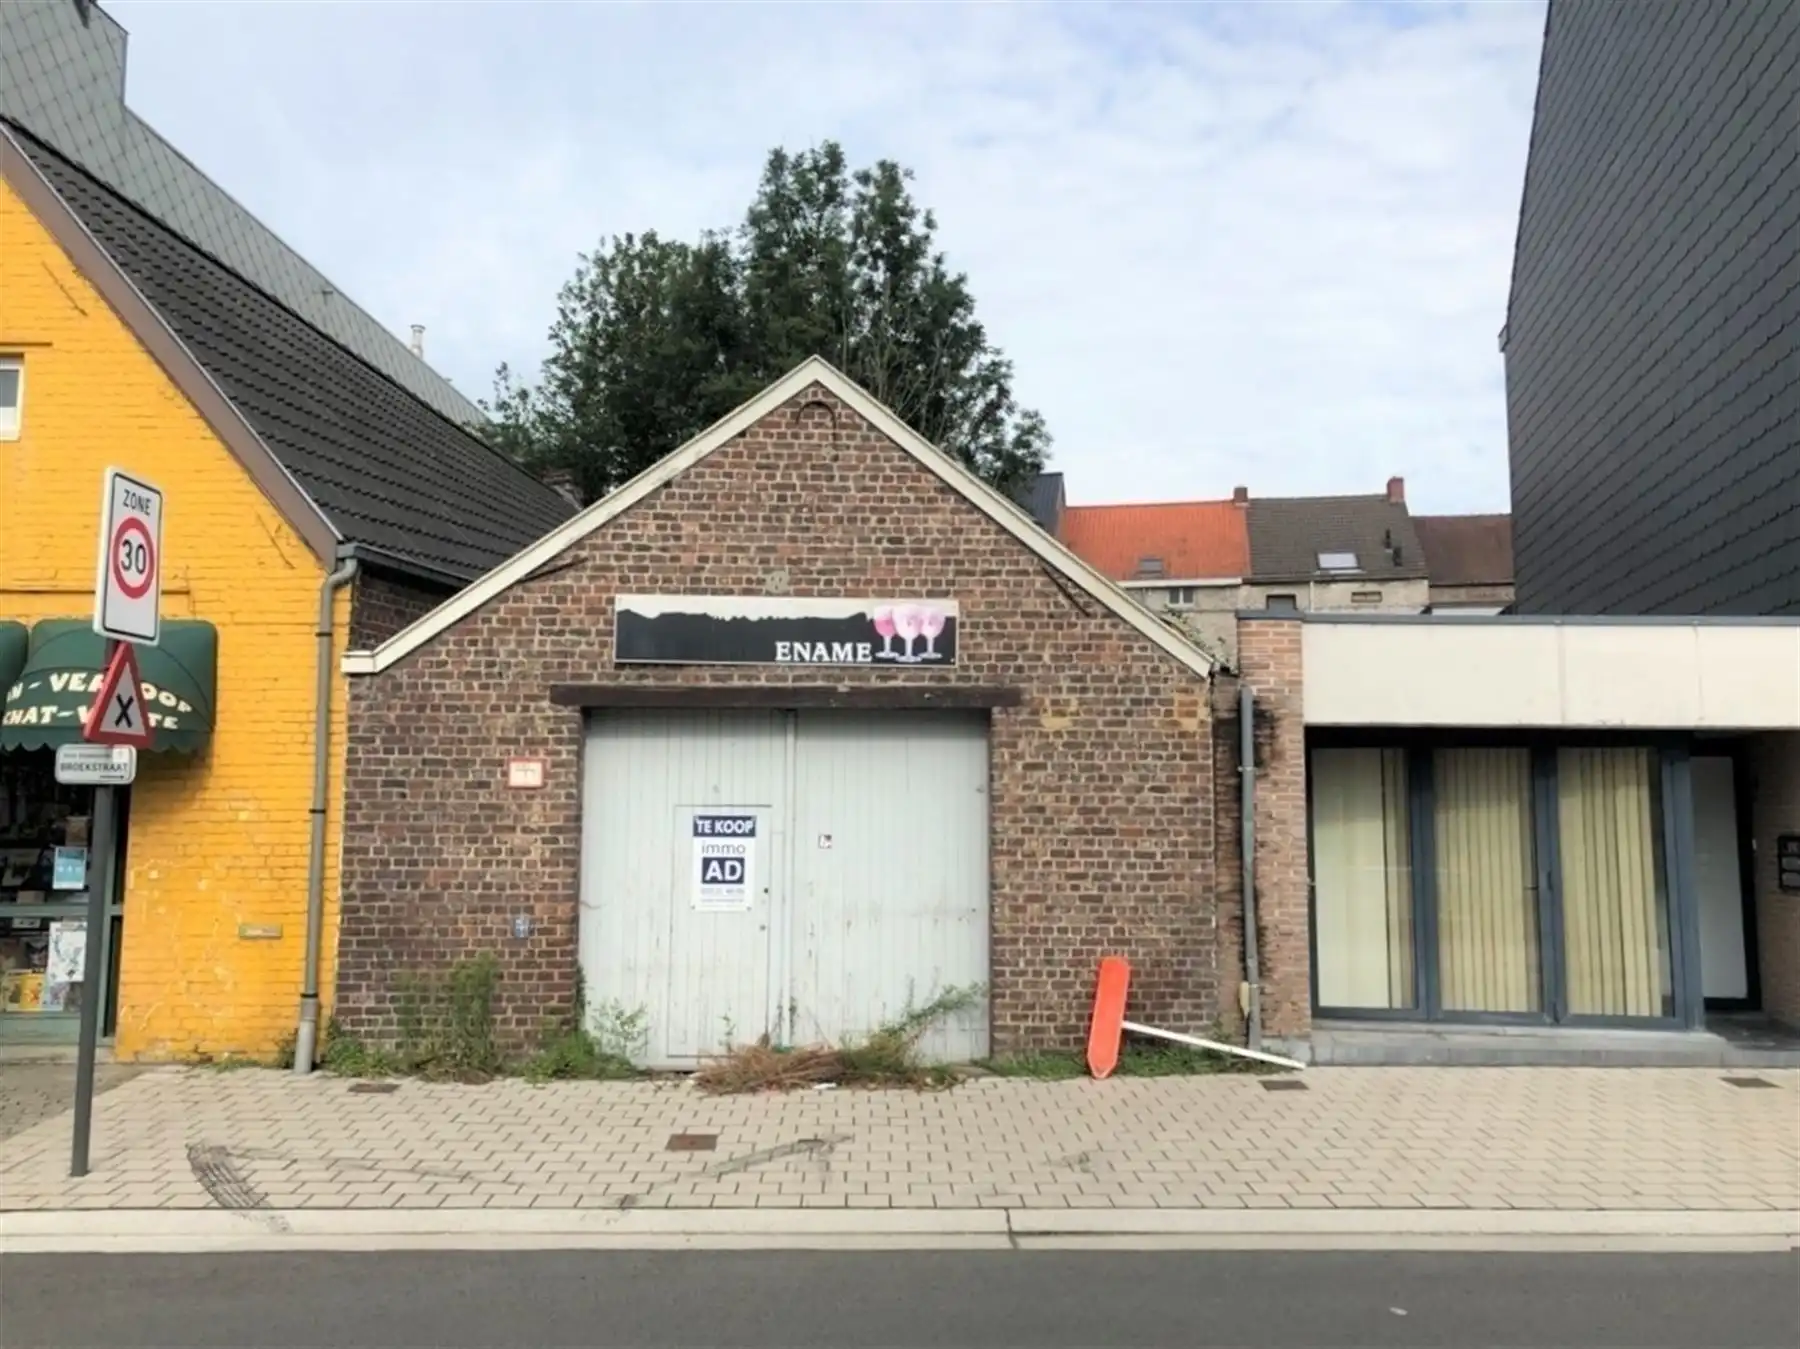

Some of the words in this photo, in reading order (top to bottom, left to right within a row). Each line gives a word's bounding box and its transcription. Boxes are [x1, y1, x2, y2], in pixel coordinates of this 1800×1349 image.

[123, 488, 151, 516] ZONE
[121, 538, 147, 575] 30
[774, 641, 873, 663] ENAME
[696, 819, 713, 834] TE
[714, 819, 754, 834] KOOP
[701, 843, 747, 854] immo
[704, 859, 743, 881] AD
